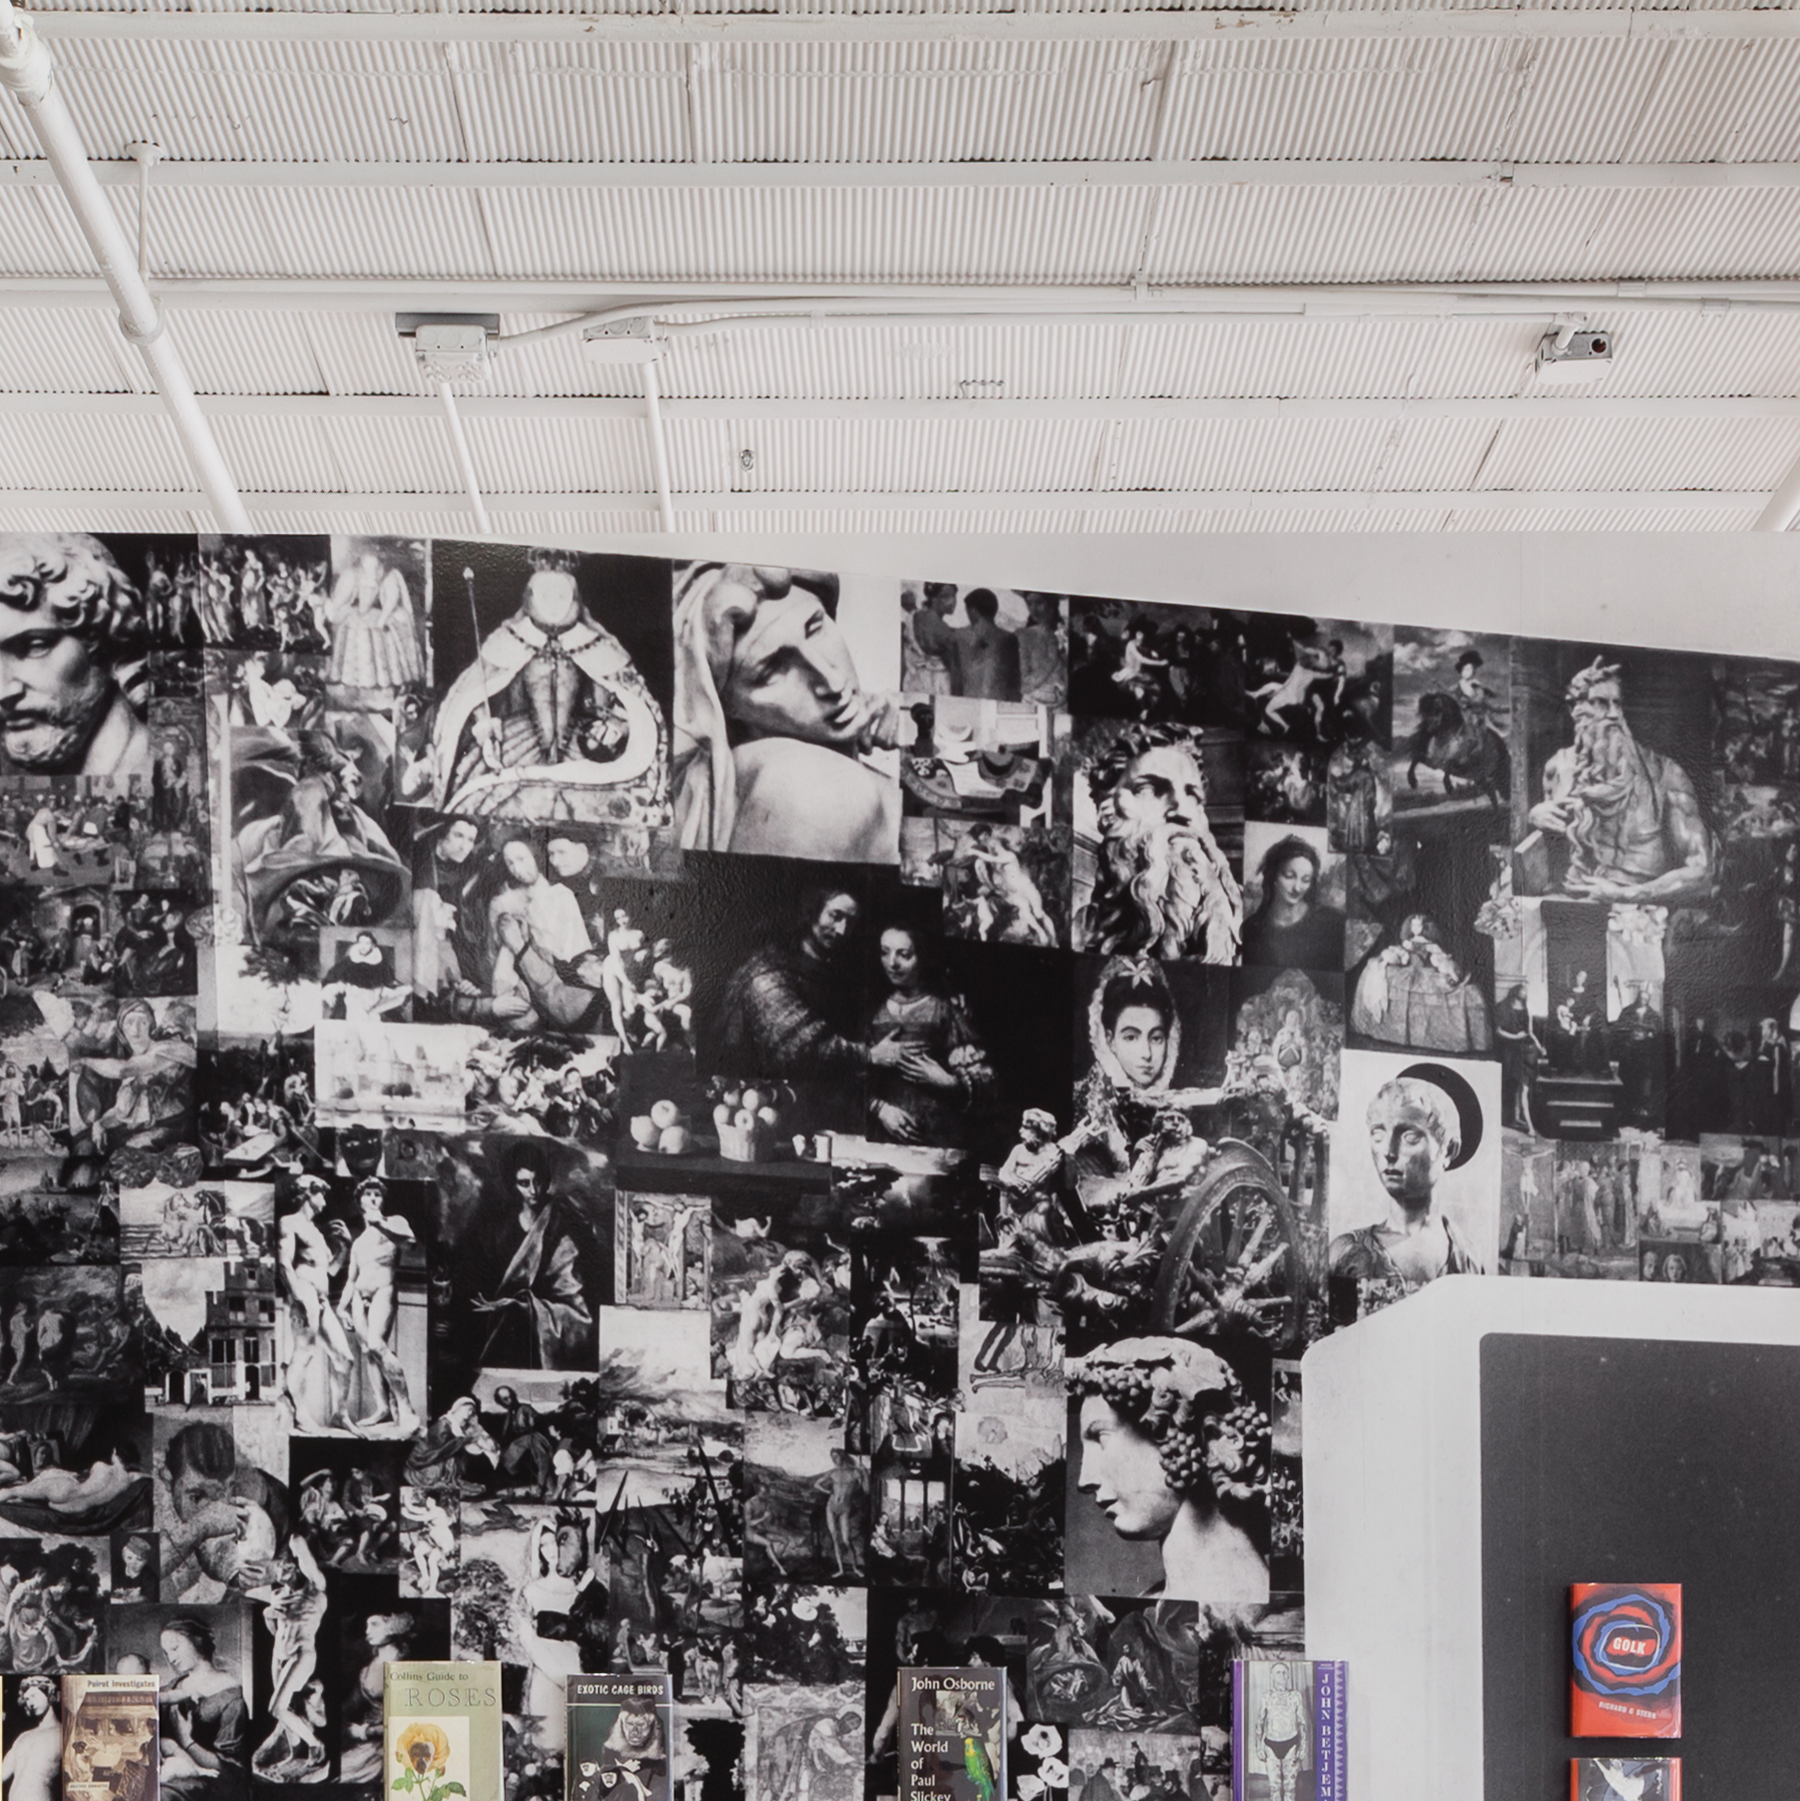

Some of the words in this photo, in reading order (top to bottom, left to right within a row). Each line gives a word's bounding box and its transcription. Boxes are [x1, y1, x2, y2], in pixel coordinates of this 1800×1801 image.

[1613, 1637, 1646, 1655] GOLK
[390, 1672, 423, 1680] Collins
[426, 1672, 455, 1681] Guide
[112, 1680, 155, 1689] Investigates
[577, 1685, 609, 1695] EXOTIC
[611, 1685, 634, 1695] CAGE
[637, 1685, 664, 1695] BIRDS
[910, 1677, 940, 1691] John
[943, 1677, 995, 1690] Osborne
[404, 1687, 496, 1707] ROSES
[1320, 1674, 1332, 1720] JOHN
[911, 1723, 934, 1736] The
[911, 1741, 948, 1753] World
[911, 1757, 924, 1770] of
[911, 1774, 935, 1786] Paul
